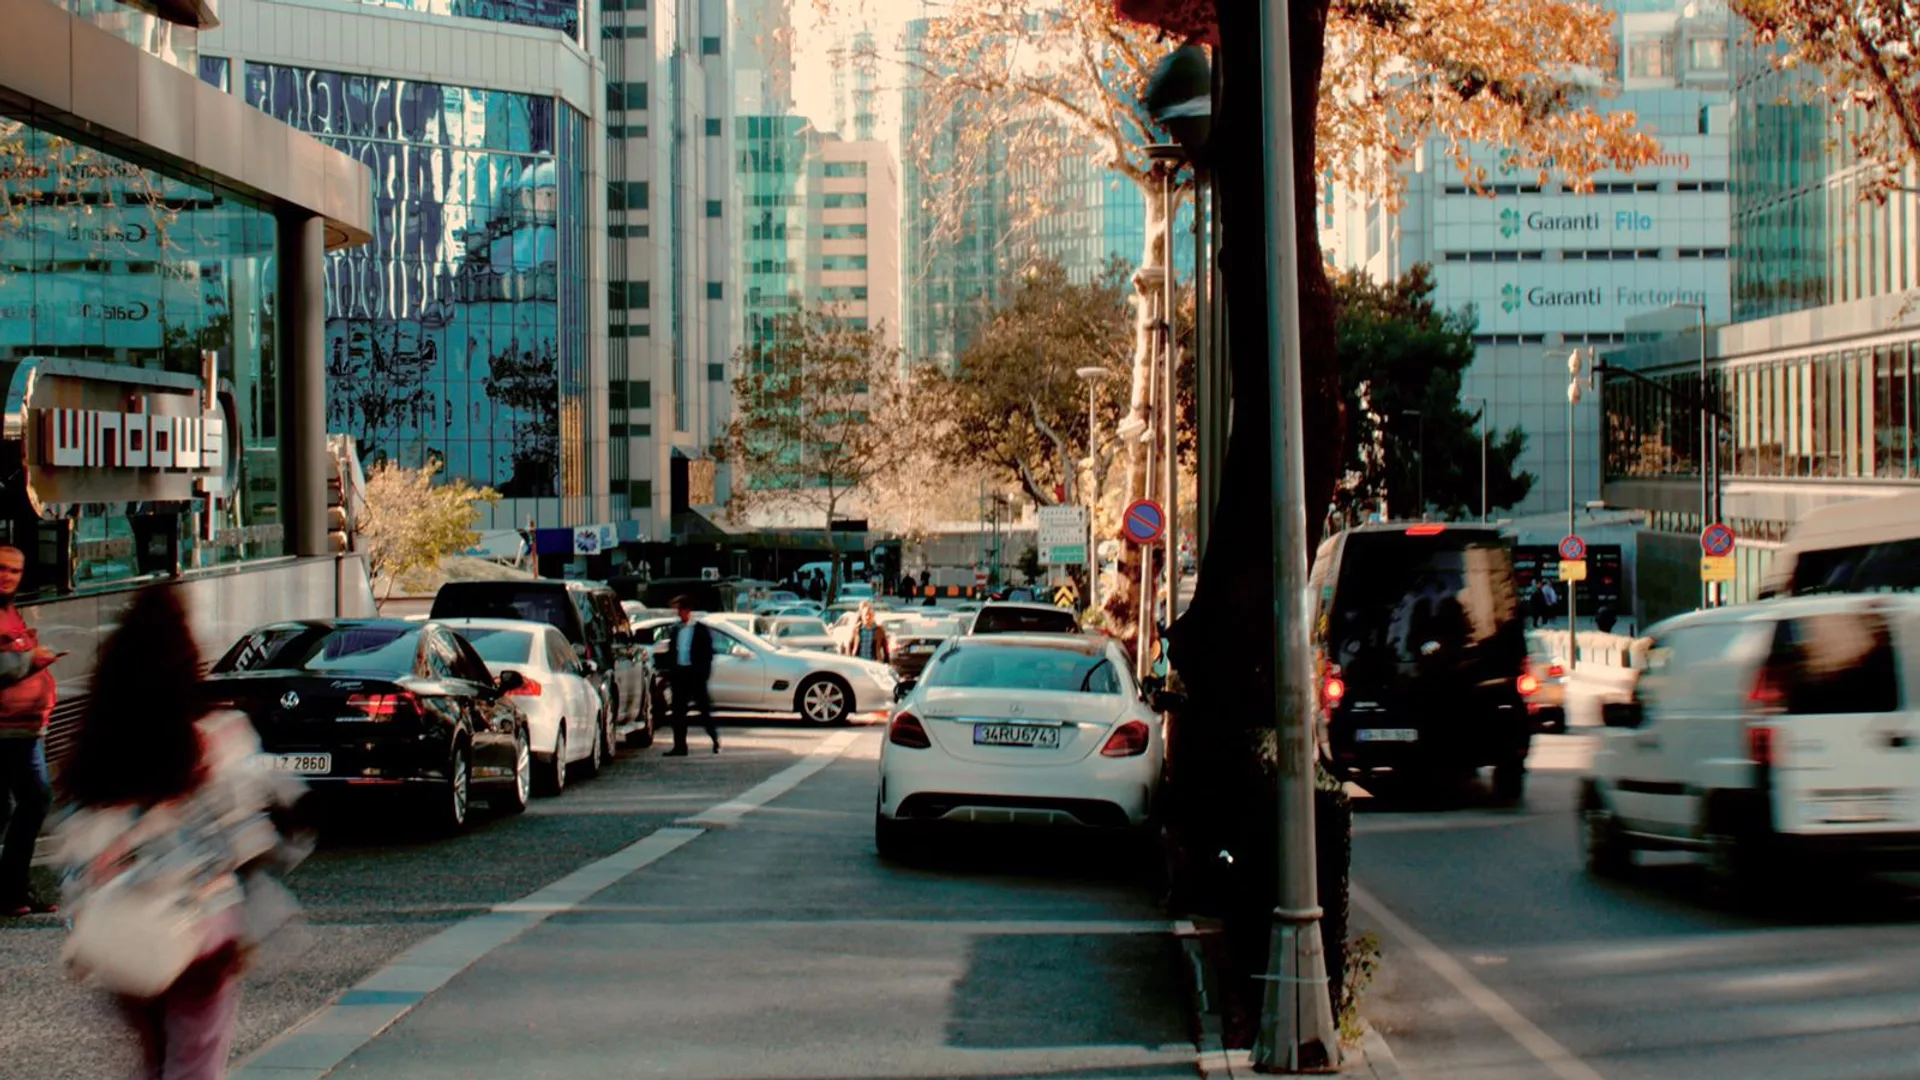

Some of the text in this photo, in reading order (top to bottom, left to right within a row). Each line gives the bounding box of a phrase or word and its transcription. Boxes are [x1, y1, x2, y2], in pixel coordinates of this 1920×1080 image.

[1527, 211, 1653, 231] Garanti Filo
[1527, 286, 1707, 307] Garanti Factoring
[294, 756, 326, 770] 2860
